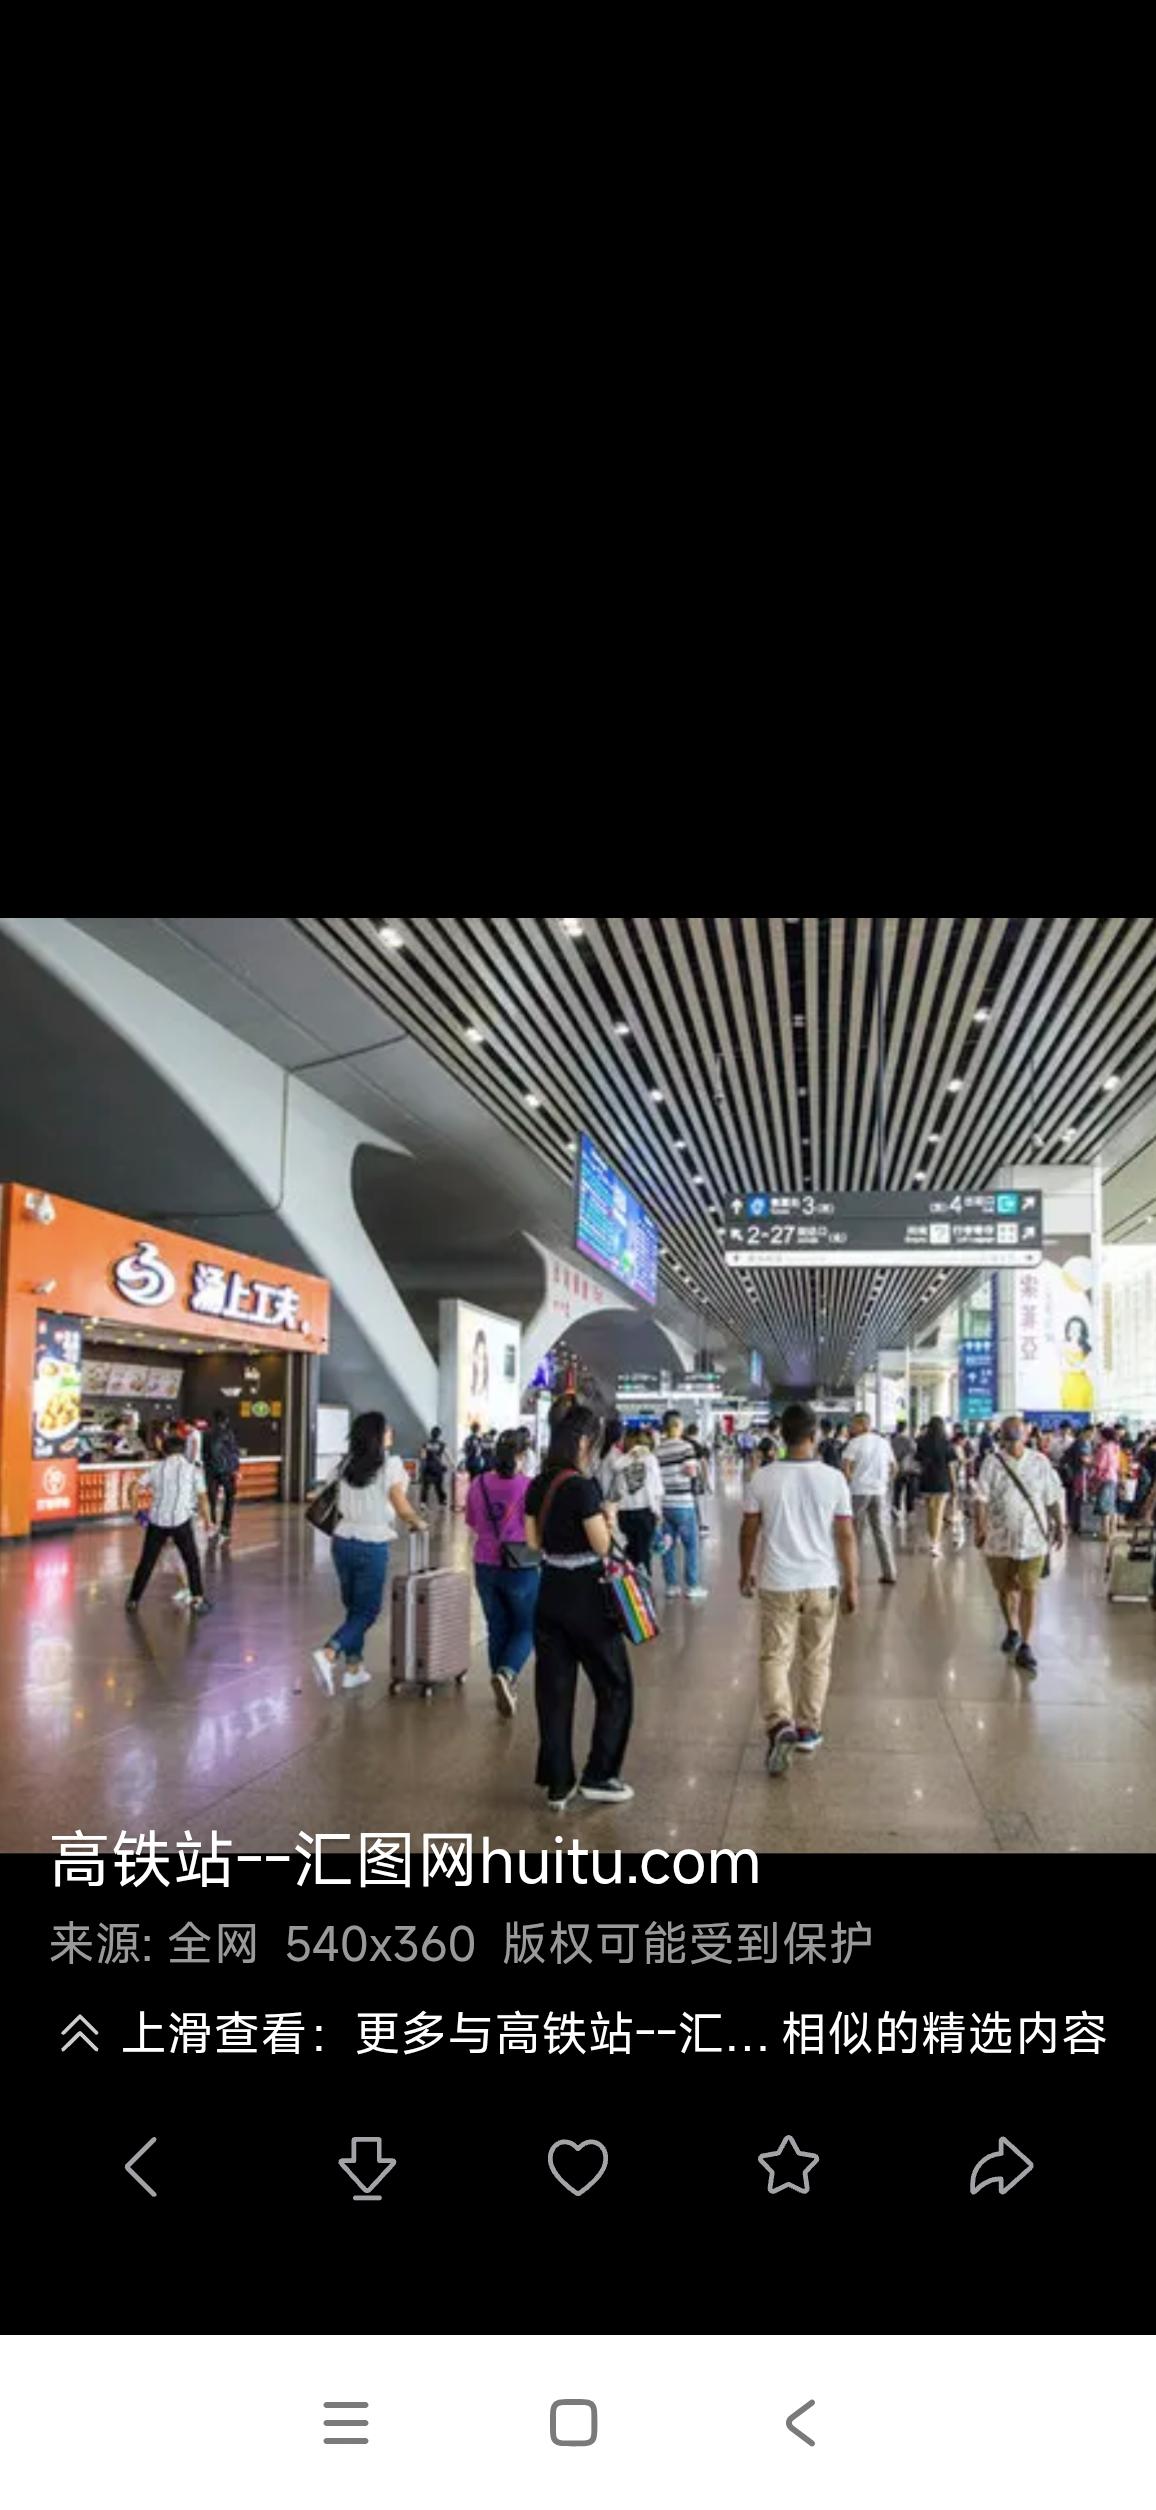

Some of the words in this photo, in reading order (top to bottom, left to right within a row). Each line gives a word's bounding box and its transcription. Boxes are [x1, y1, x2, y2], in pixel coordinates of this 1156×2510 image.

[802, 1195, 815, 1216] 3
[949, 1194, 962, 1215] 4
[747, 1225, 797, 1245] 2-27
